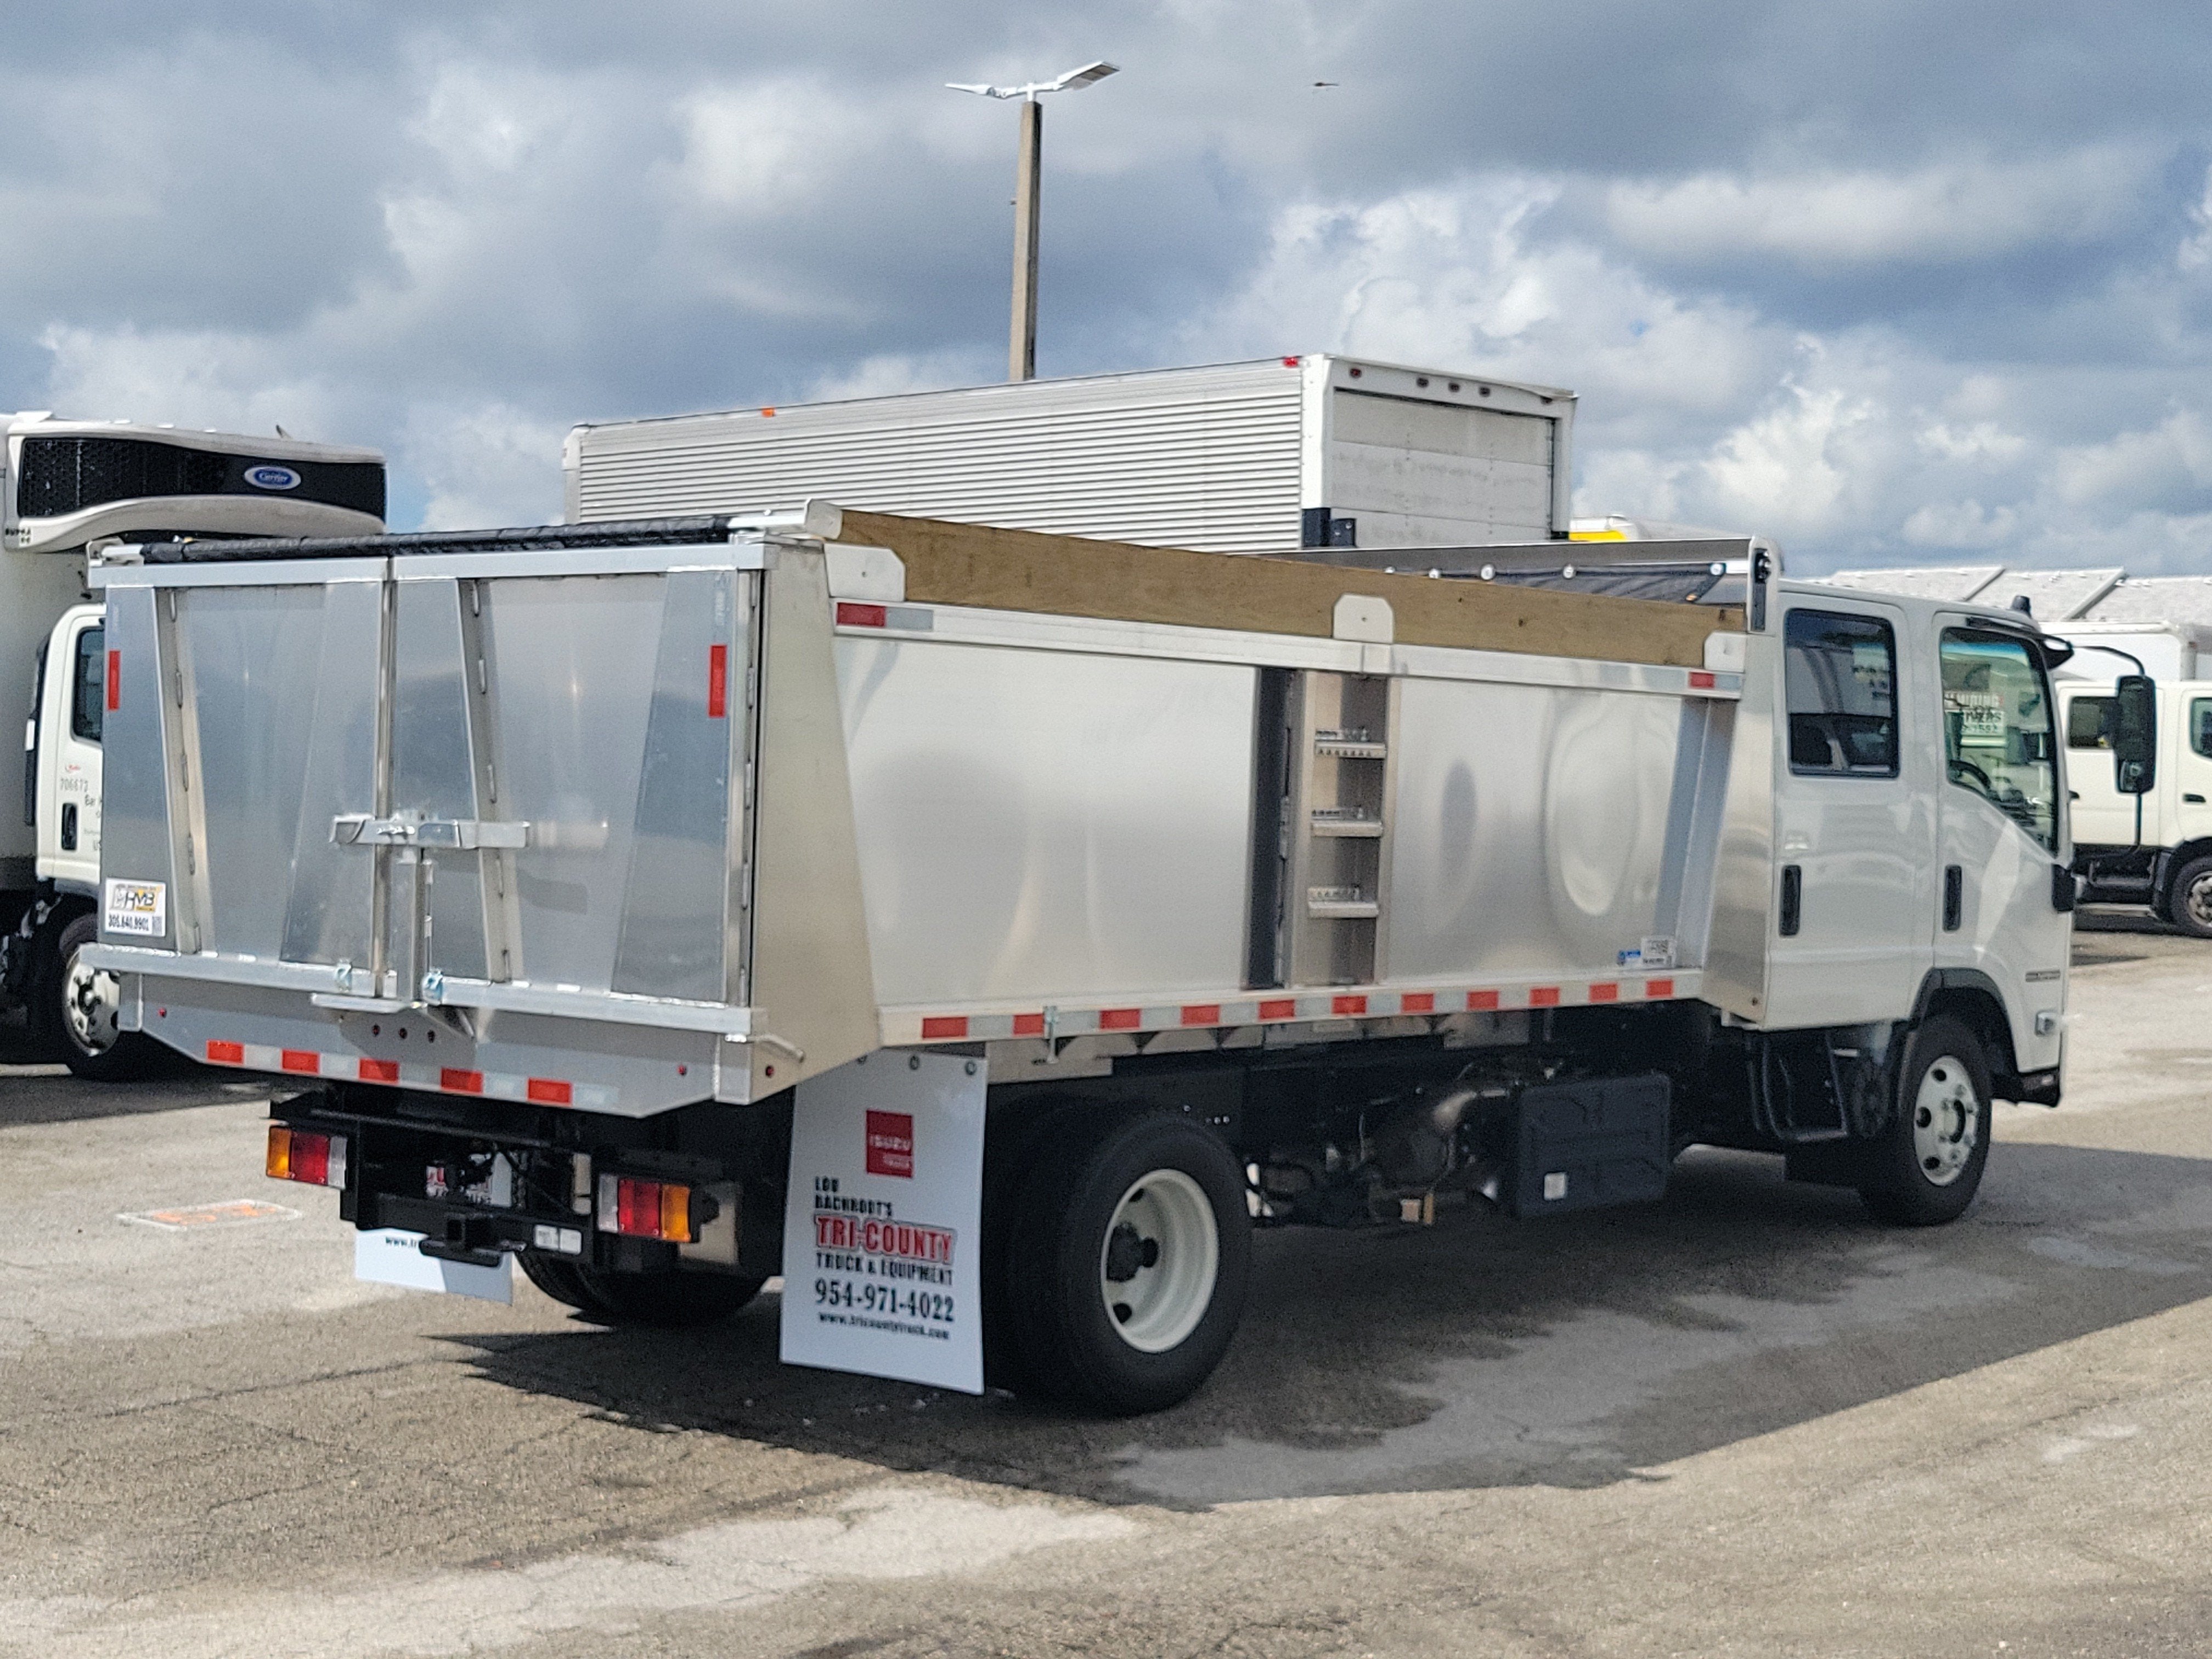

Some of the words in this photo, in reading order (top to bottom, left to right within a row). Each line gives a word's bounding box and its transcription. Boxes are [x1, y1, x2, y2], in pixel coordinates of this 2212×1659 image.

[816, 1216, 953, 1263] TRI-COUNTY
[816, 1252, 863, 1273] TRUCK
[881, 1259, 953, 1286] EQUIPMENT
[815, 1279, 954, 1323] 954-971-4022
